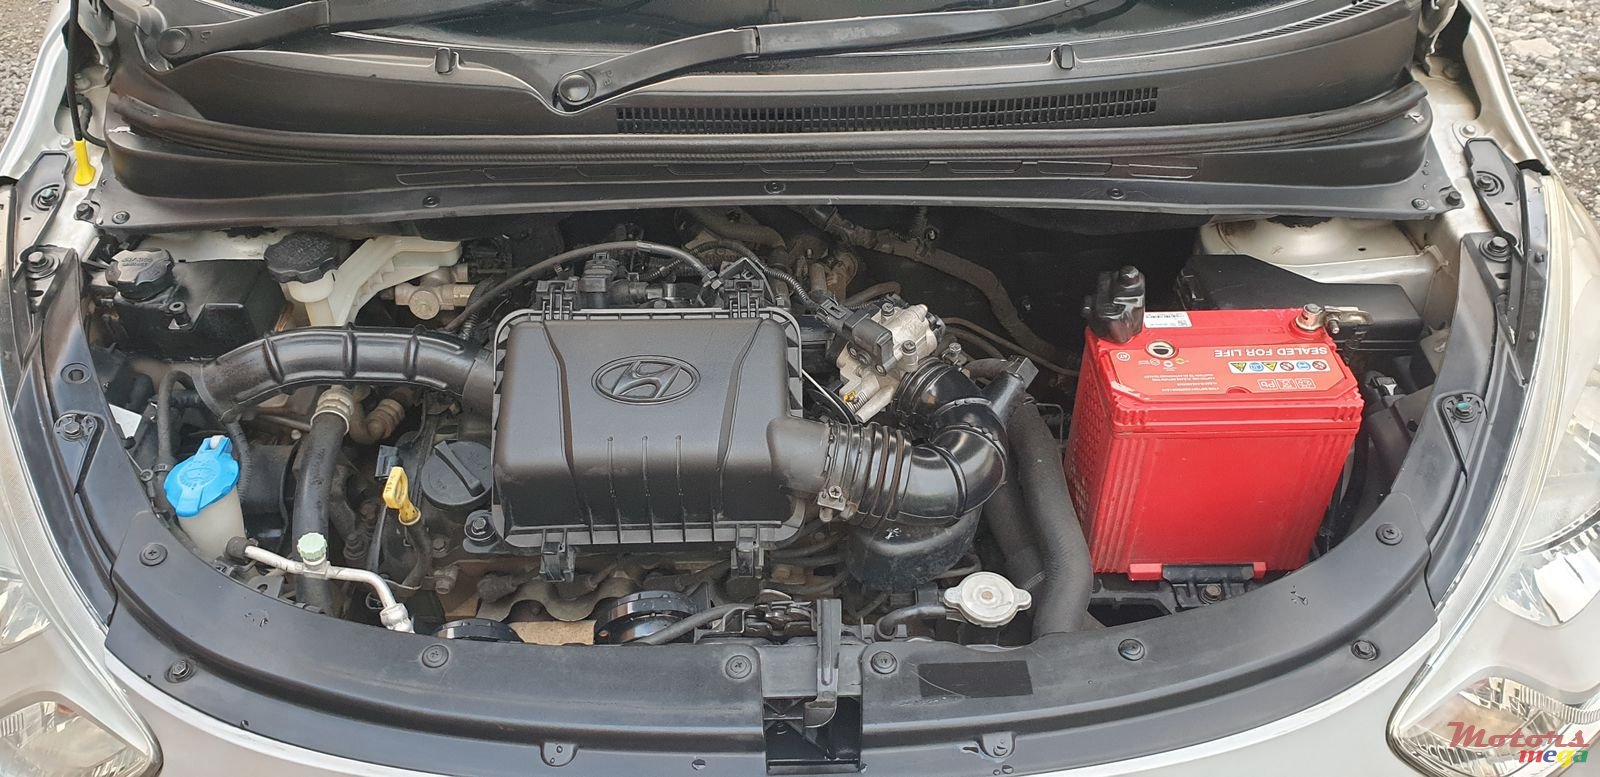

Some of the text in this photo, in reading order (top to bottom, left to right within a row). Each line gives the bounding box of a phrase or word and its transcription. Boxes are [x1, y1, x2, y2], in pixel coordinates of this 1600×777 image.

[1214, 347, 1328, 358] SEALED FOR LIFE
